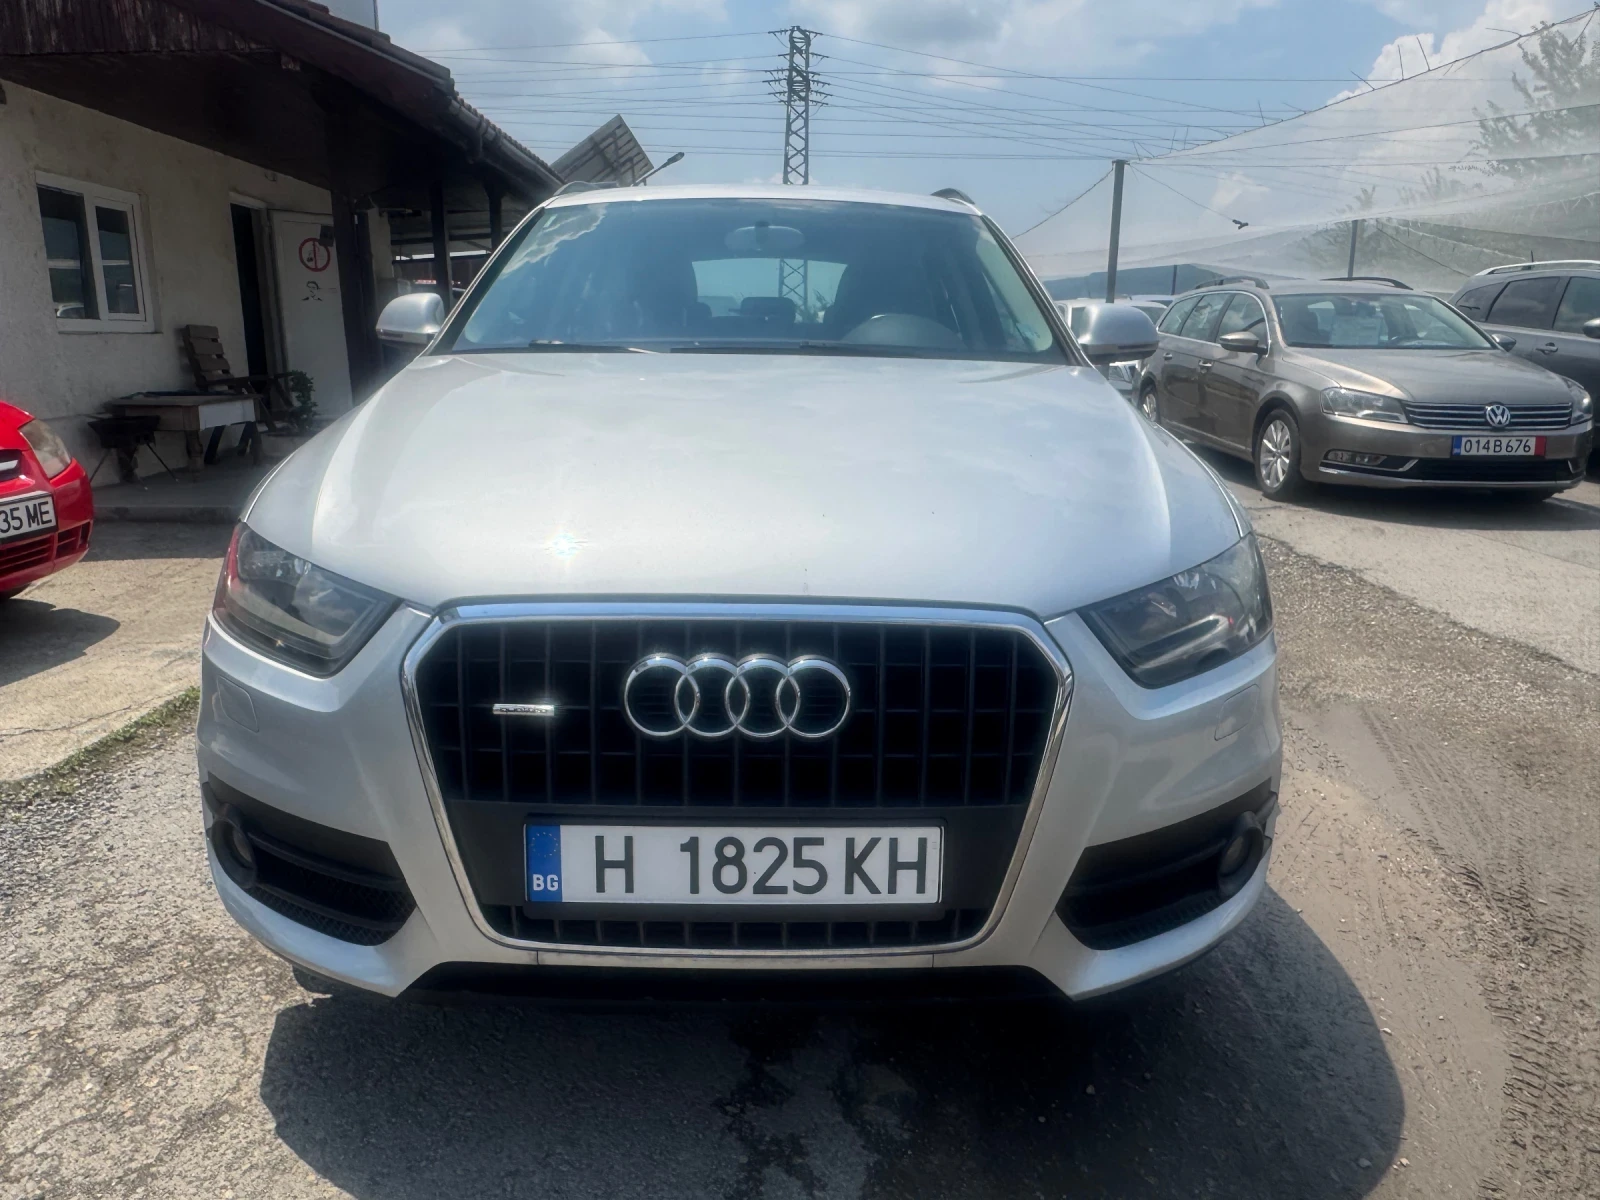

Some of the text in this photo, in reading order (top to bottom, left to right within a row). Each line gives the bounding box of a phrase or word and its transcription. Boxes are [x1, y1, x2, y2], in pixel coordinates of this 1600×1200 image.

[1486, 404, 1511, 428] VW
[25, 501, 52, 528] ME
[594, 835, 928, 895] H 1825 KH
[532, 873, 559, 891] BG
